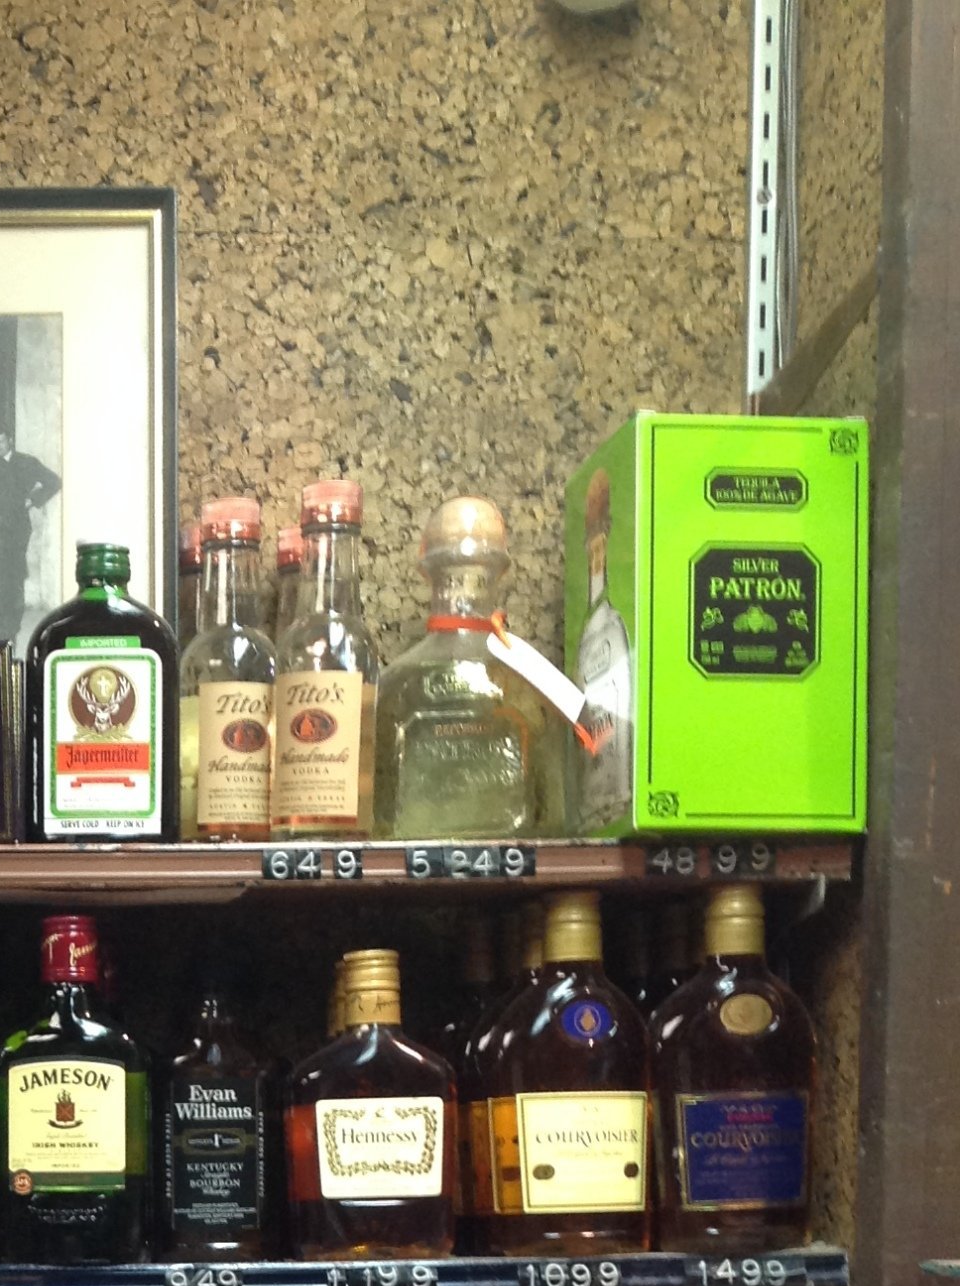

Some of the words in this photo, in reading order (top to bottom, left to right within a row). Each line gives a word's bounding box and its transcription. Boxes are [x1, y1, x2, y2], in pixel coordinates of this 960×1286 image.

[732, 477, 780, 488] TEQUILA
[732, 557, 780, 574] SILVER
[286, 682, 344, 707] Tito's
[19, 1068, 112, 1092] JAMESON
[188, 1085, 238, 1102] Evan
[173, 1103, 253, 1120] Williams
[341, 1127, 419, 1146] Hennessy
[534, 1128, 638, 1149] COURVOISIER
[186, 1162, 244, 1172] KENTUCKY
[190, 1179, 241, 1188] BOURBON
